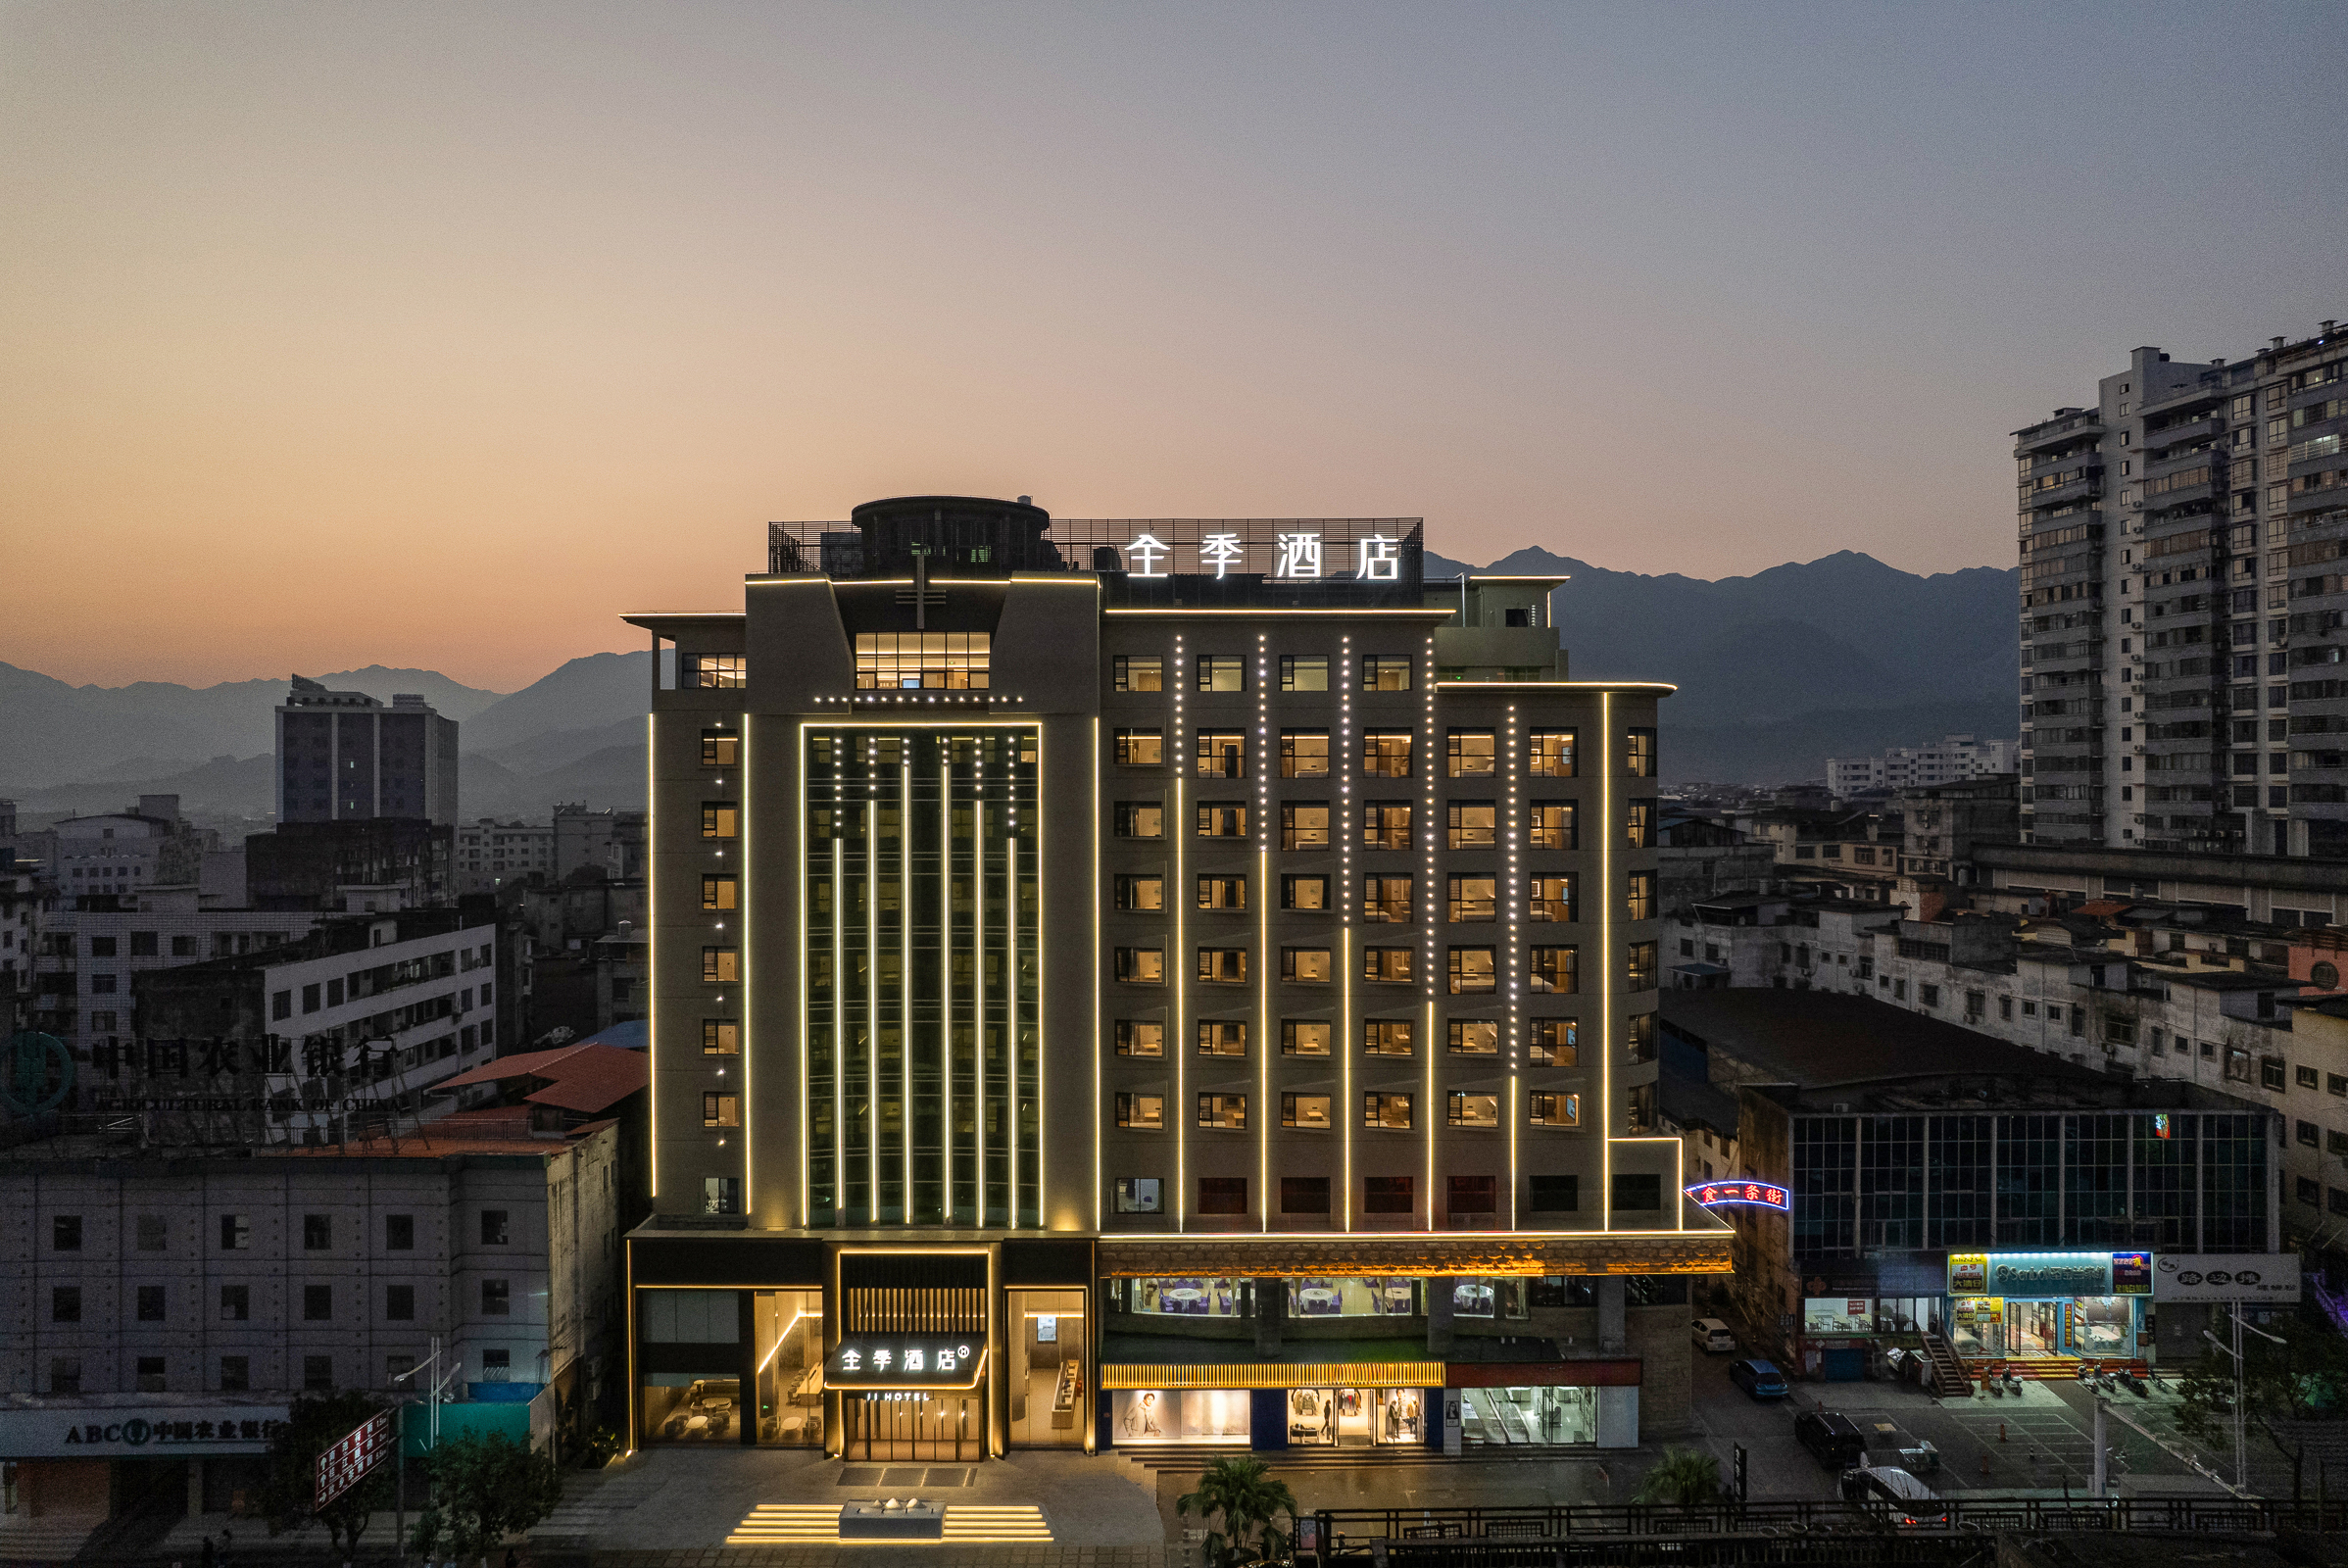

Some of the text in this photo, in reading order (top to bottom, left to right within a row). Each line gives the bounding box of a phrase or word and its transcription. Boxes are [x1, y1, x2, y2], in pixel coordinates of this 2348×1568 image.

[1124, 532, 1399, 580] 全季酒店
[93, 1034, 398, 1078] 中国农业银行
[251, 1098, 302, 1111] BANK
[311, 1098, 334, 1111] OF
[343, 1098, 402, 1111] CHINA
[842, 1348, 955, 1371] 全季酒店
[884, 1392, 930, 1401] HOTEL
[65, 1424, 121, 1444] ABC
